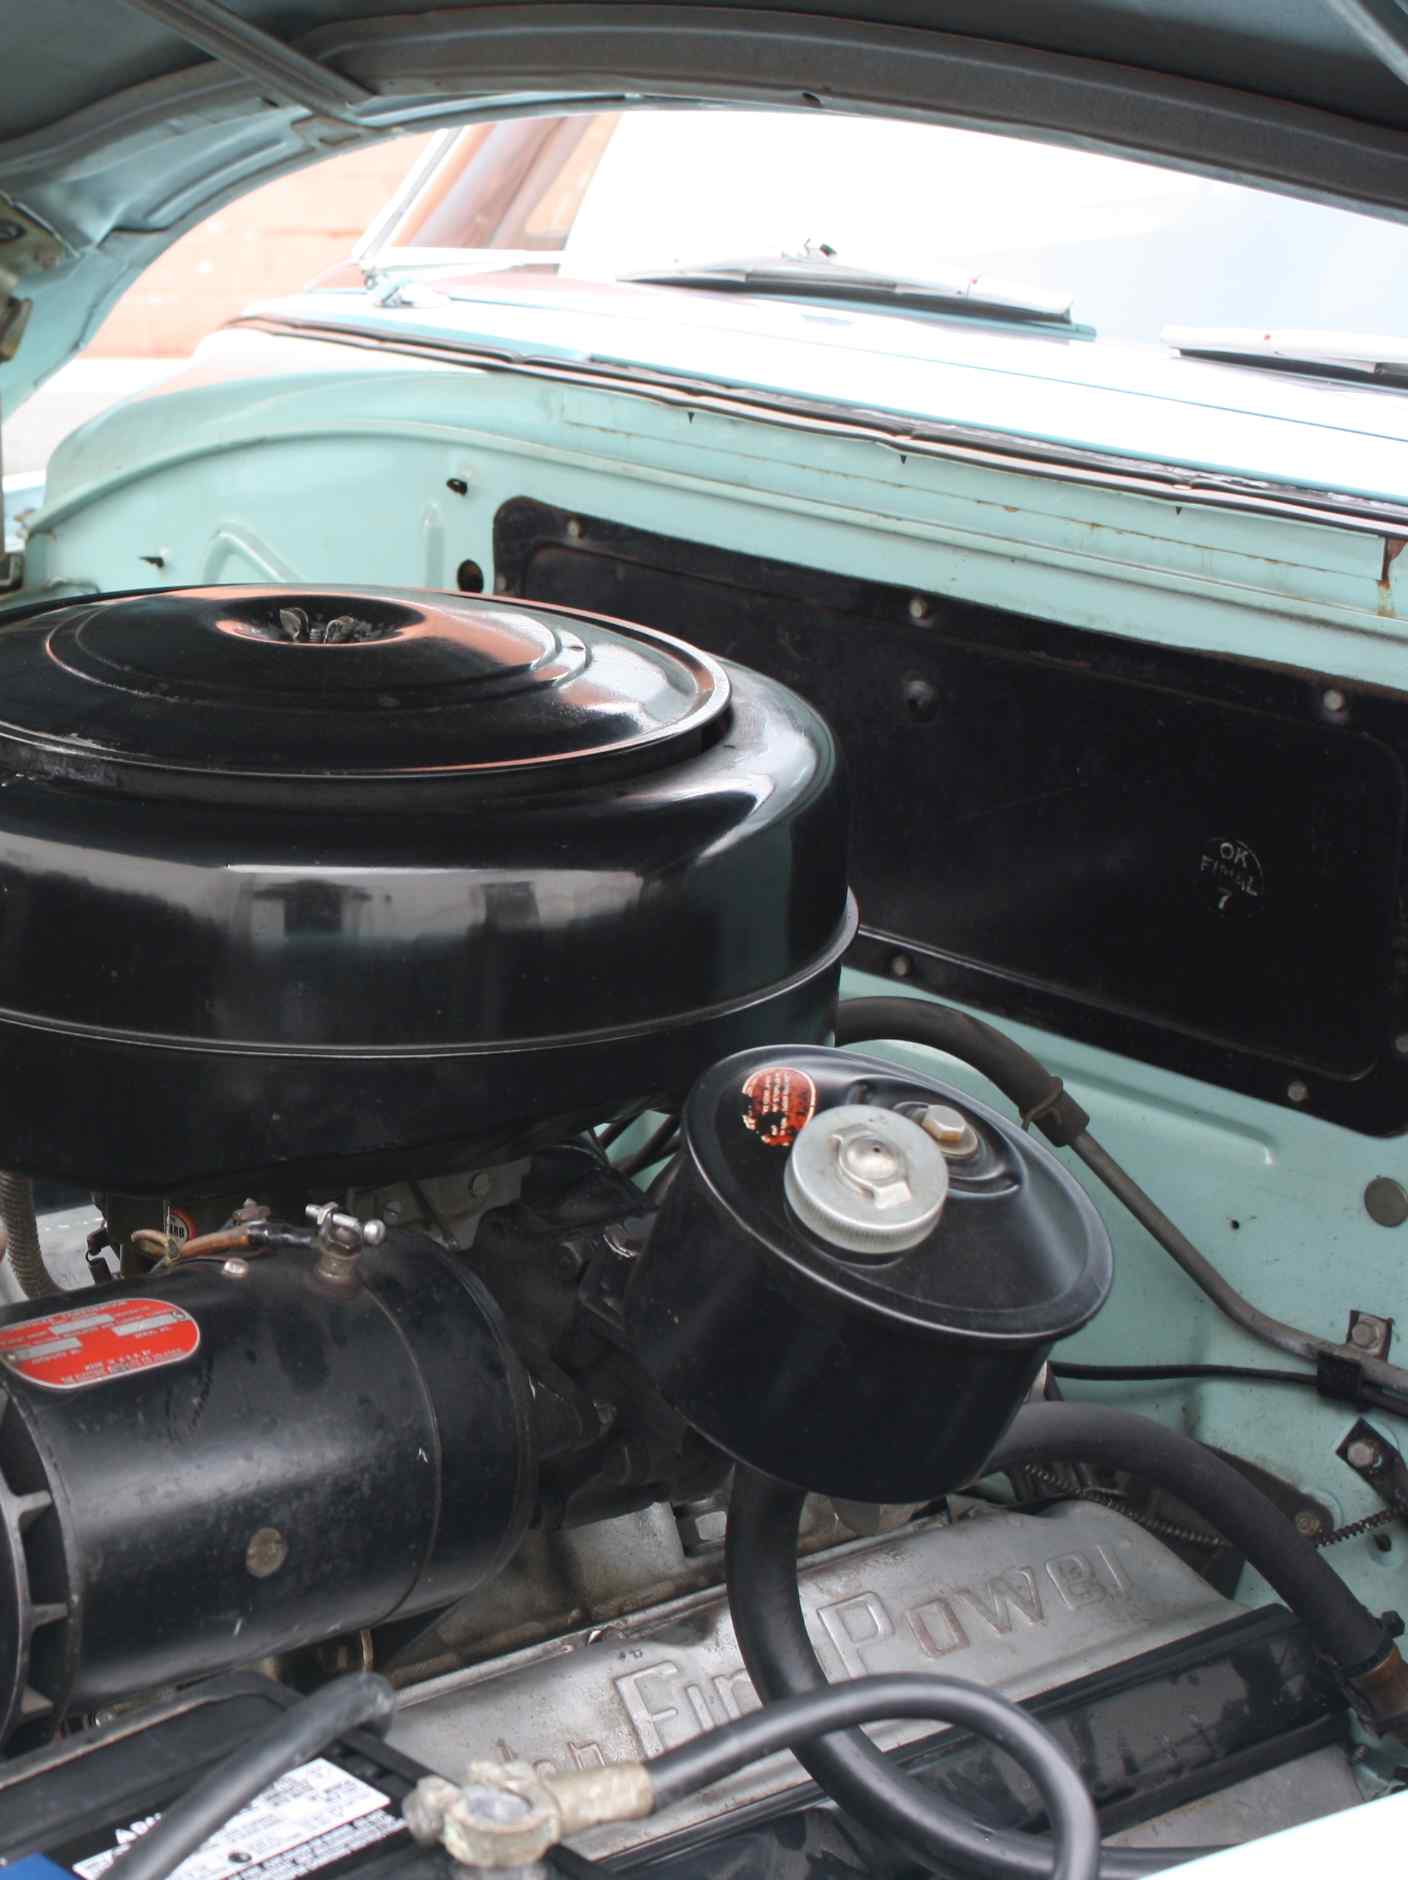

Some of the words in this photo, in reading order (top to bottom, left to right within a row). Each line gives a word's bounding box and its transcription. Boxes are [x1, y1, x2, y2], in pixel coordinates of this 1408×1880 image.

[1219, 841, 1249, 868] OK
[1217, 886, 1233, 910] 7
[612, 1660, 762, 1762] Fir
